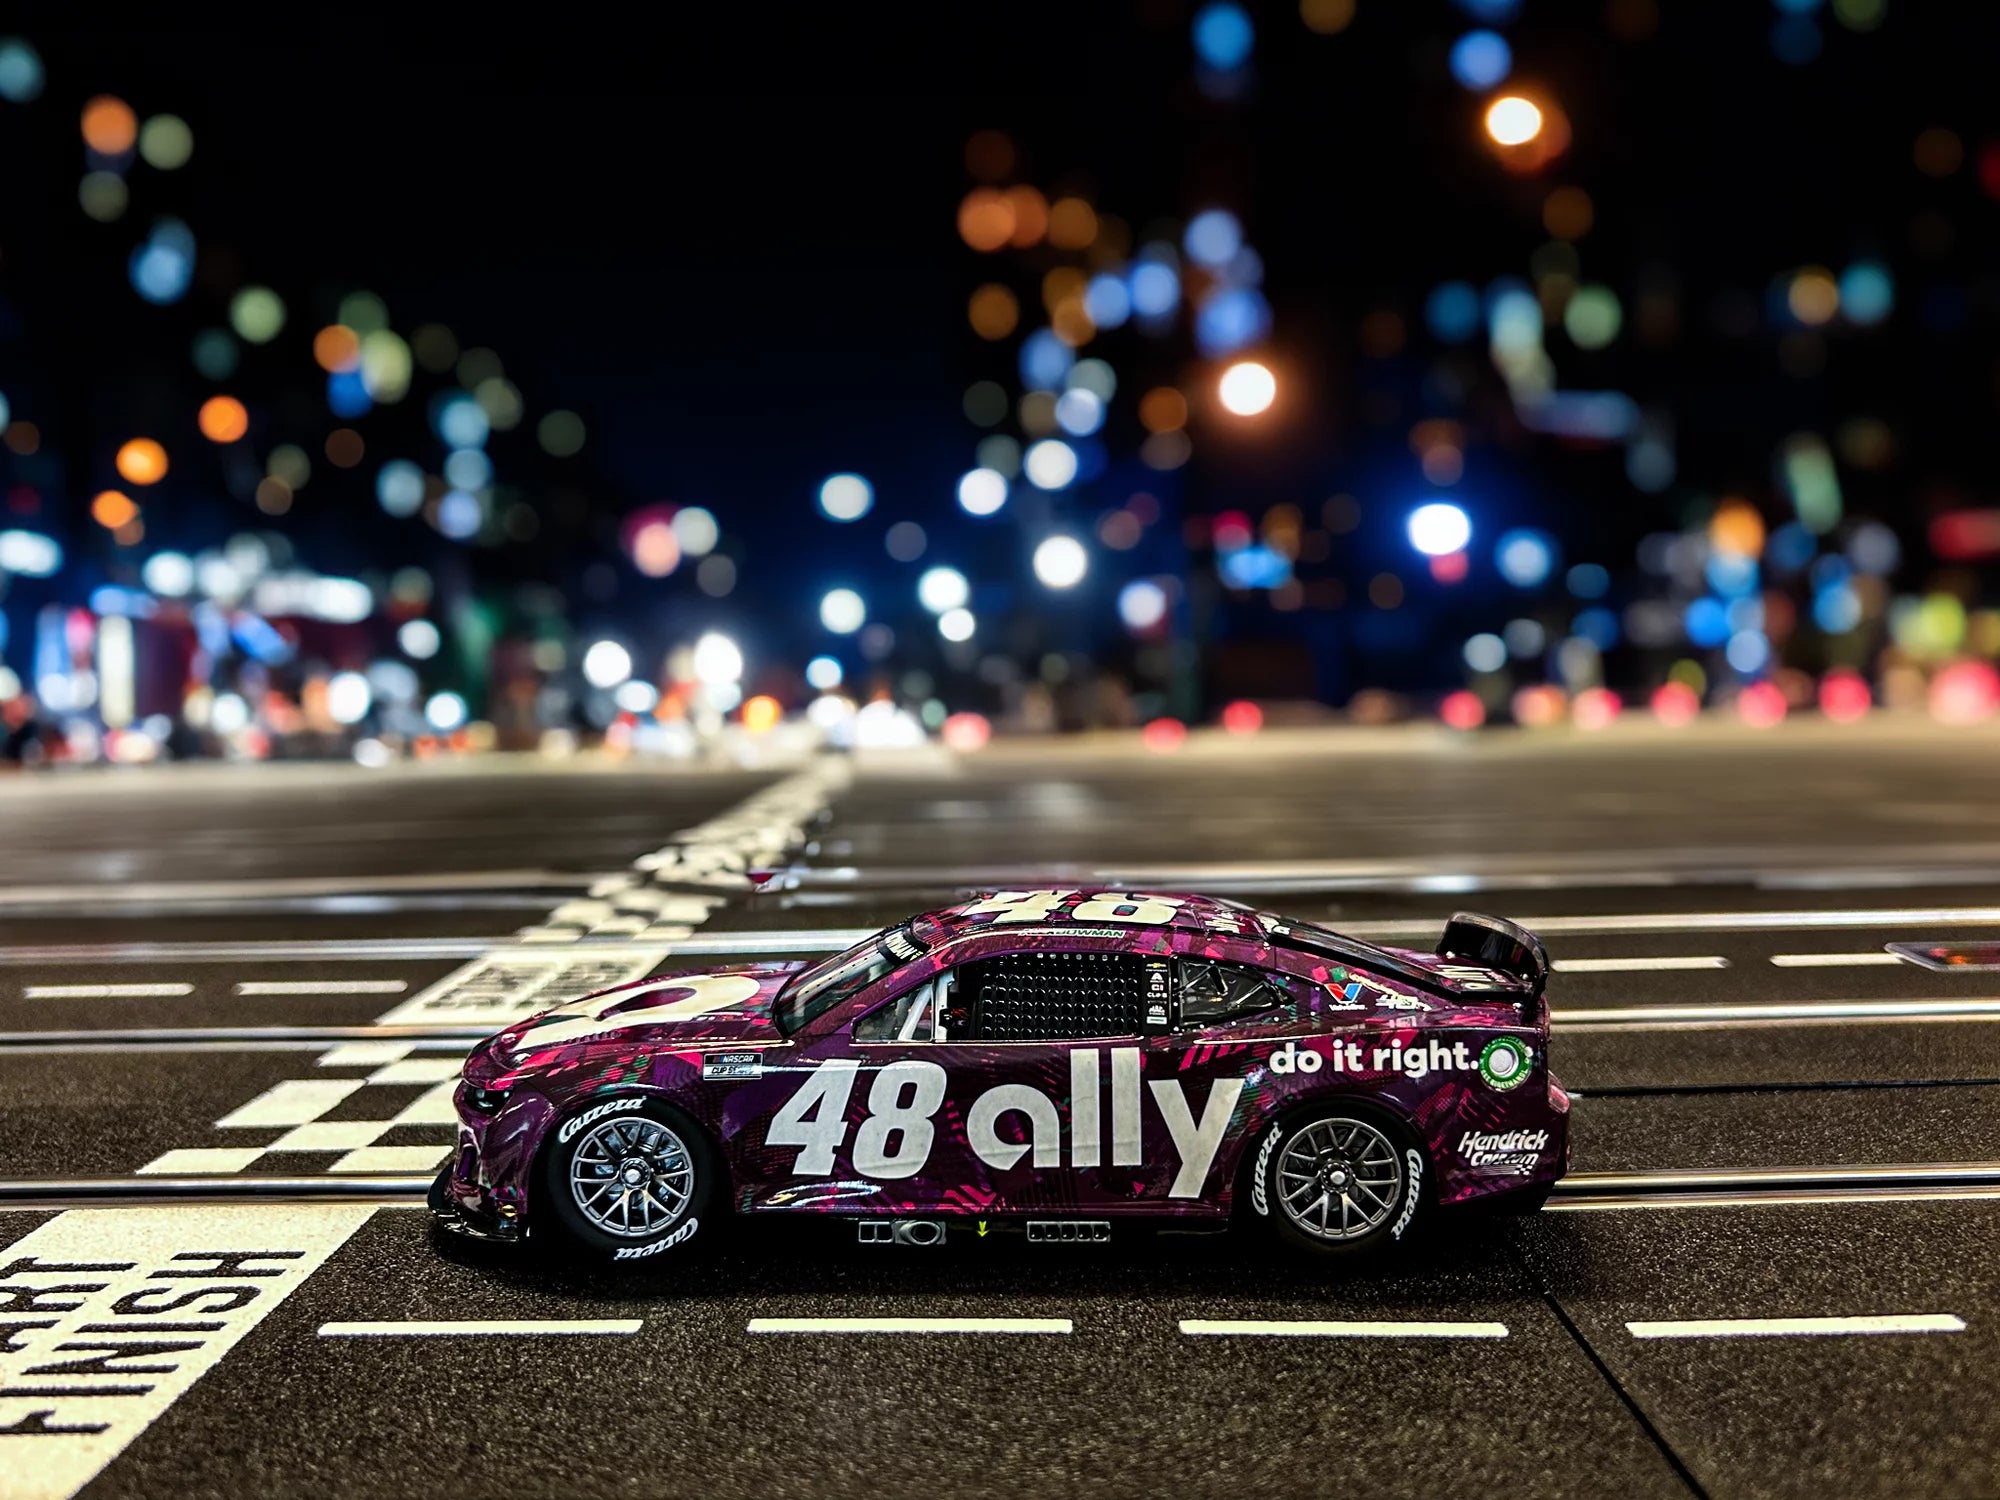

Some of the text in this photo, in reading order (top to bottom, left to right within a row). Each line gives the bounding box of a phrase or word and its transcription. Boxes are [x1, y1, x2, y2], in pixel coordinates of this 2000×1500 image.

[722, 1055, 755, 1063] NASCAR
[1269, 1042, 1323, 1073] do
[1332, 1039, 1364, 1072] it
[1373, 1038, 1479, 1078] right.
[558, 1095, 647, 1143] Carrera
[764, 1058, 948, 1180] 48
[966, 1047, 1246, 1198] ally
[1457, 1129, 1549, 1158] Hendrick
[1251, 1121, 1283, 1216] Carrera
[1391, 1148, 1423, 1240] Carrera
[613, 1217, 699, 1260] Carrera
[0, 1250, 306, 1435] FINISH
